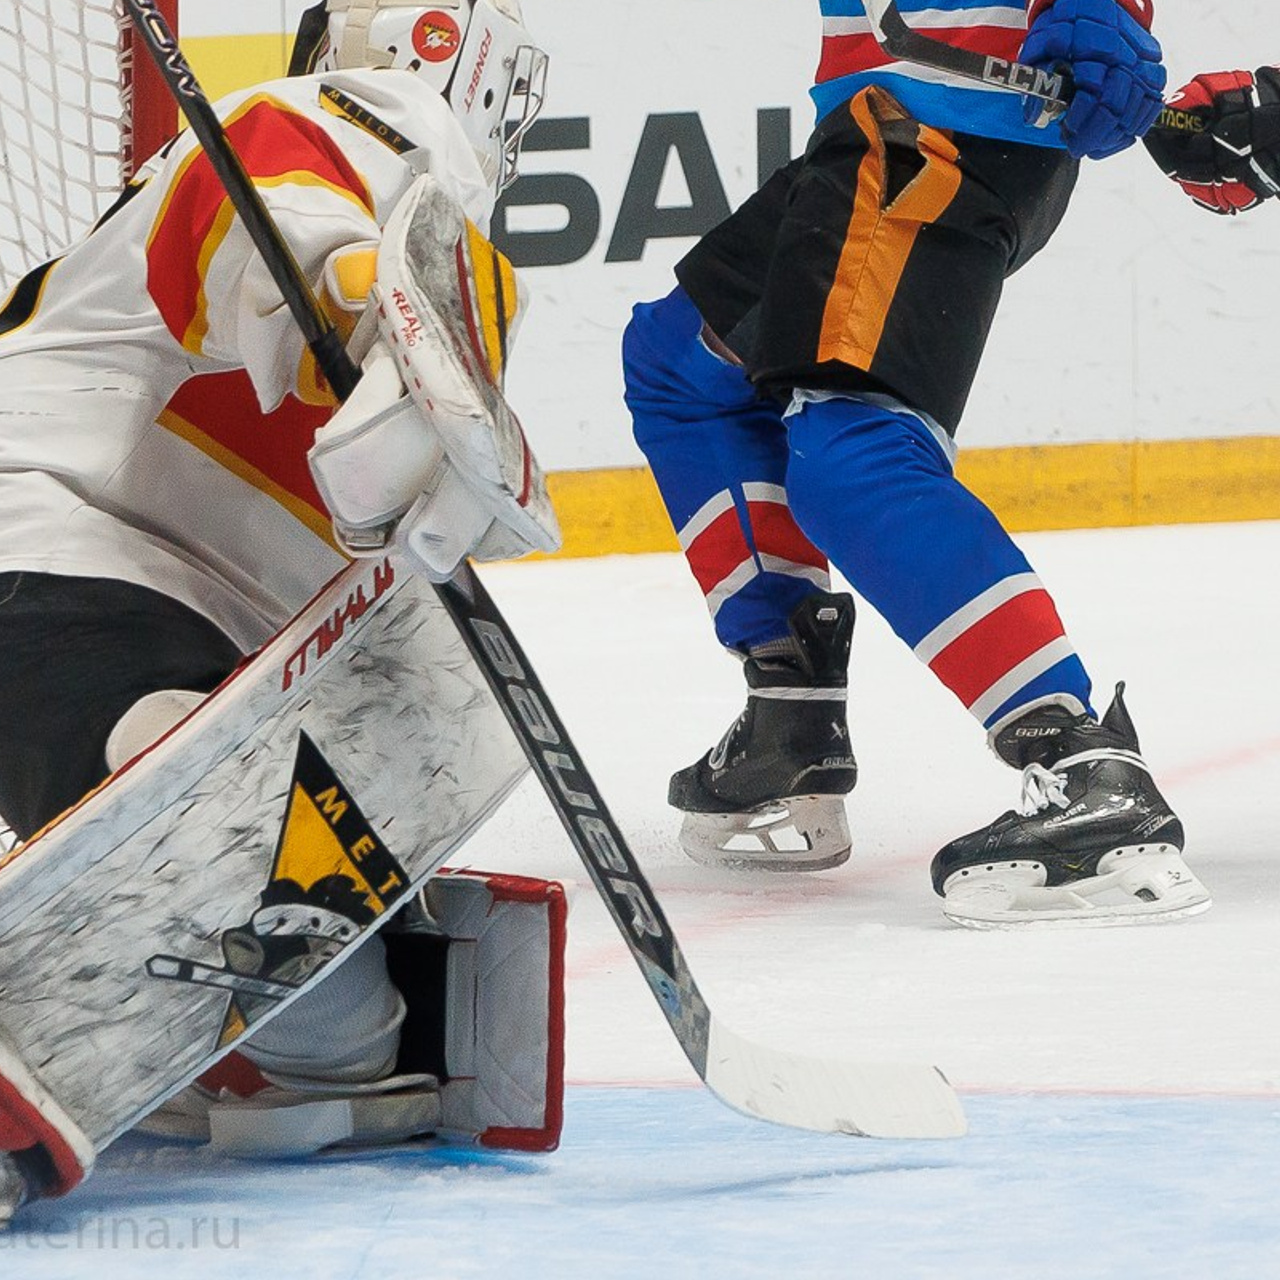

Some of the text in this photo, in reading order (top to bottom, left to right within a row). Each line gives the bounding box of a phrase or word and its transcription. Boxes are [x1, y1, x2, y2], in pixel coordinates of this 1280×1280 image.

[464, 28, 492, 114] FONBET
[983, 56, 1063, 102] CCM
[470, 619, 663, 939] BAUER
